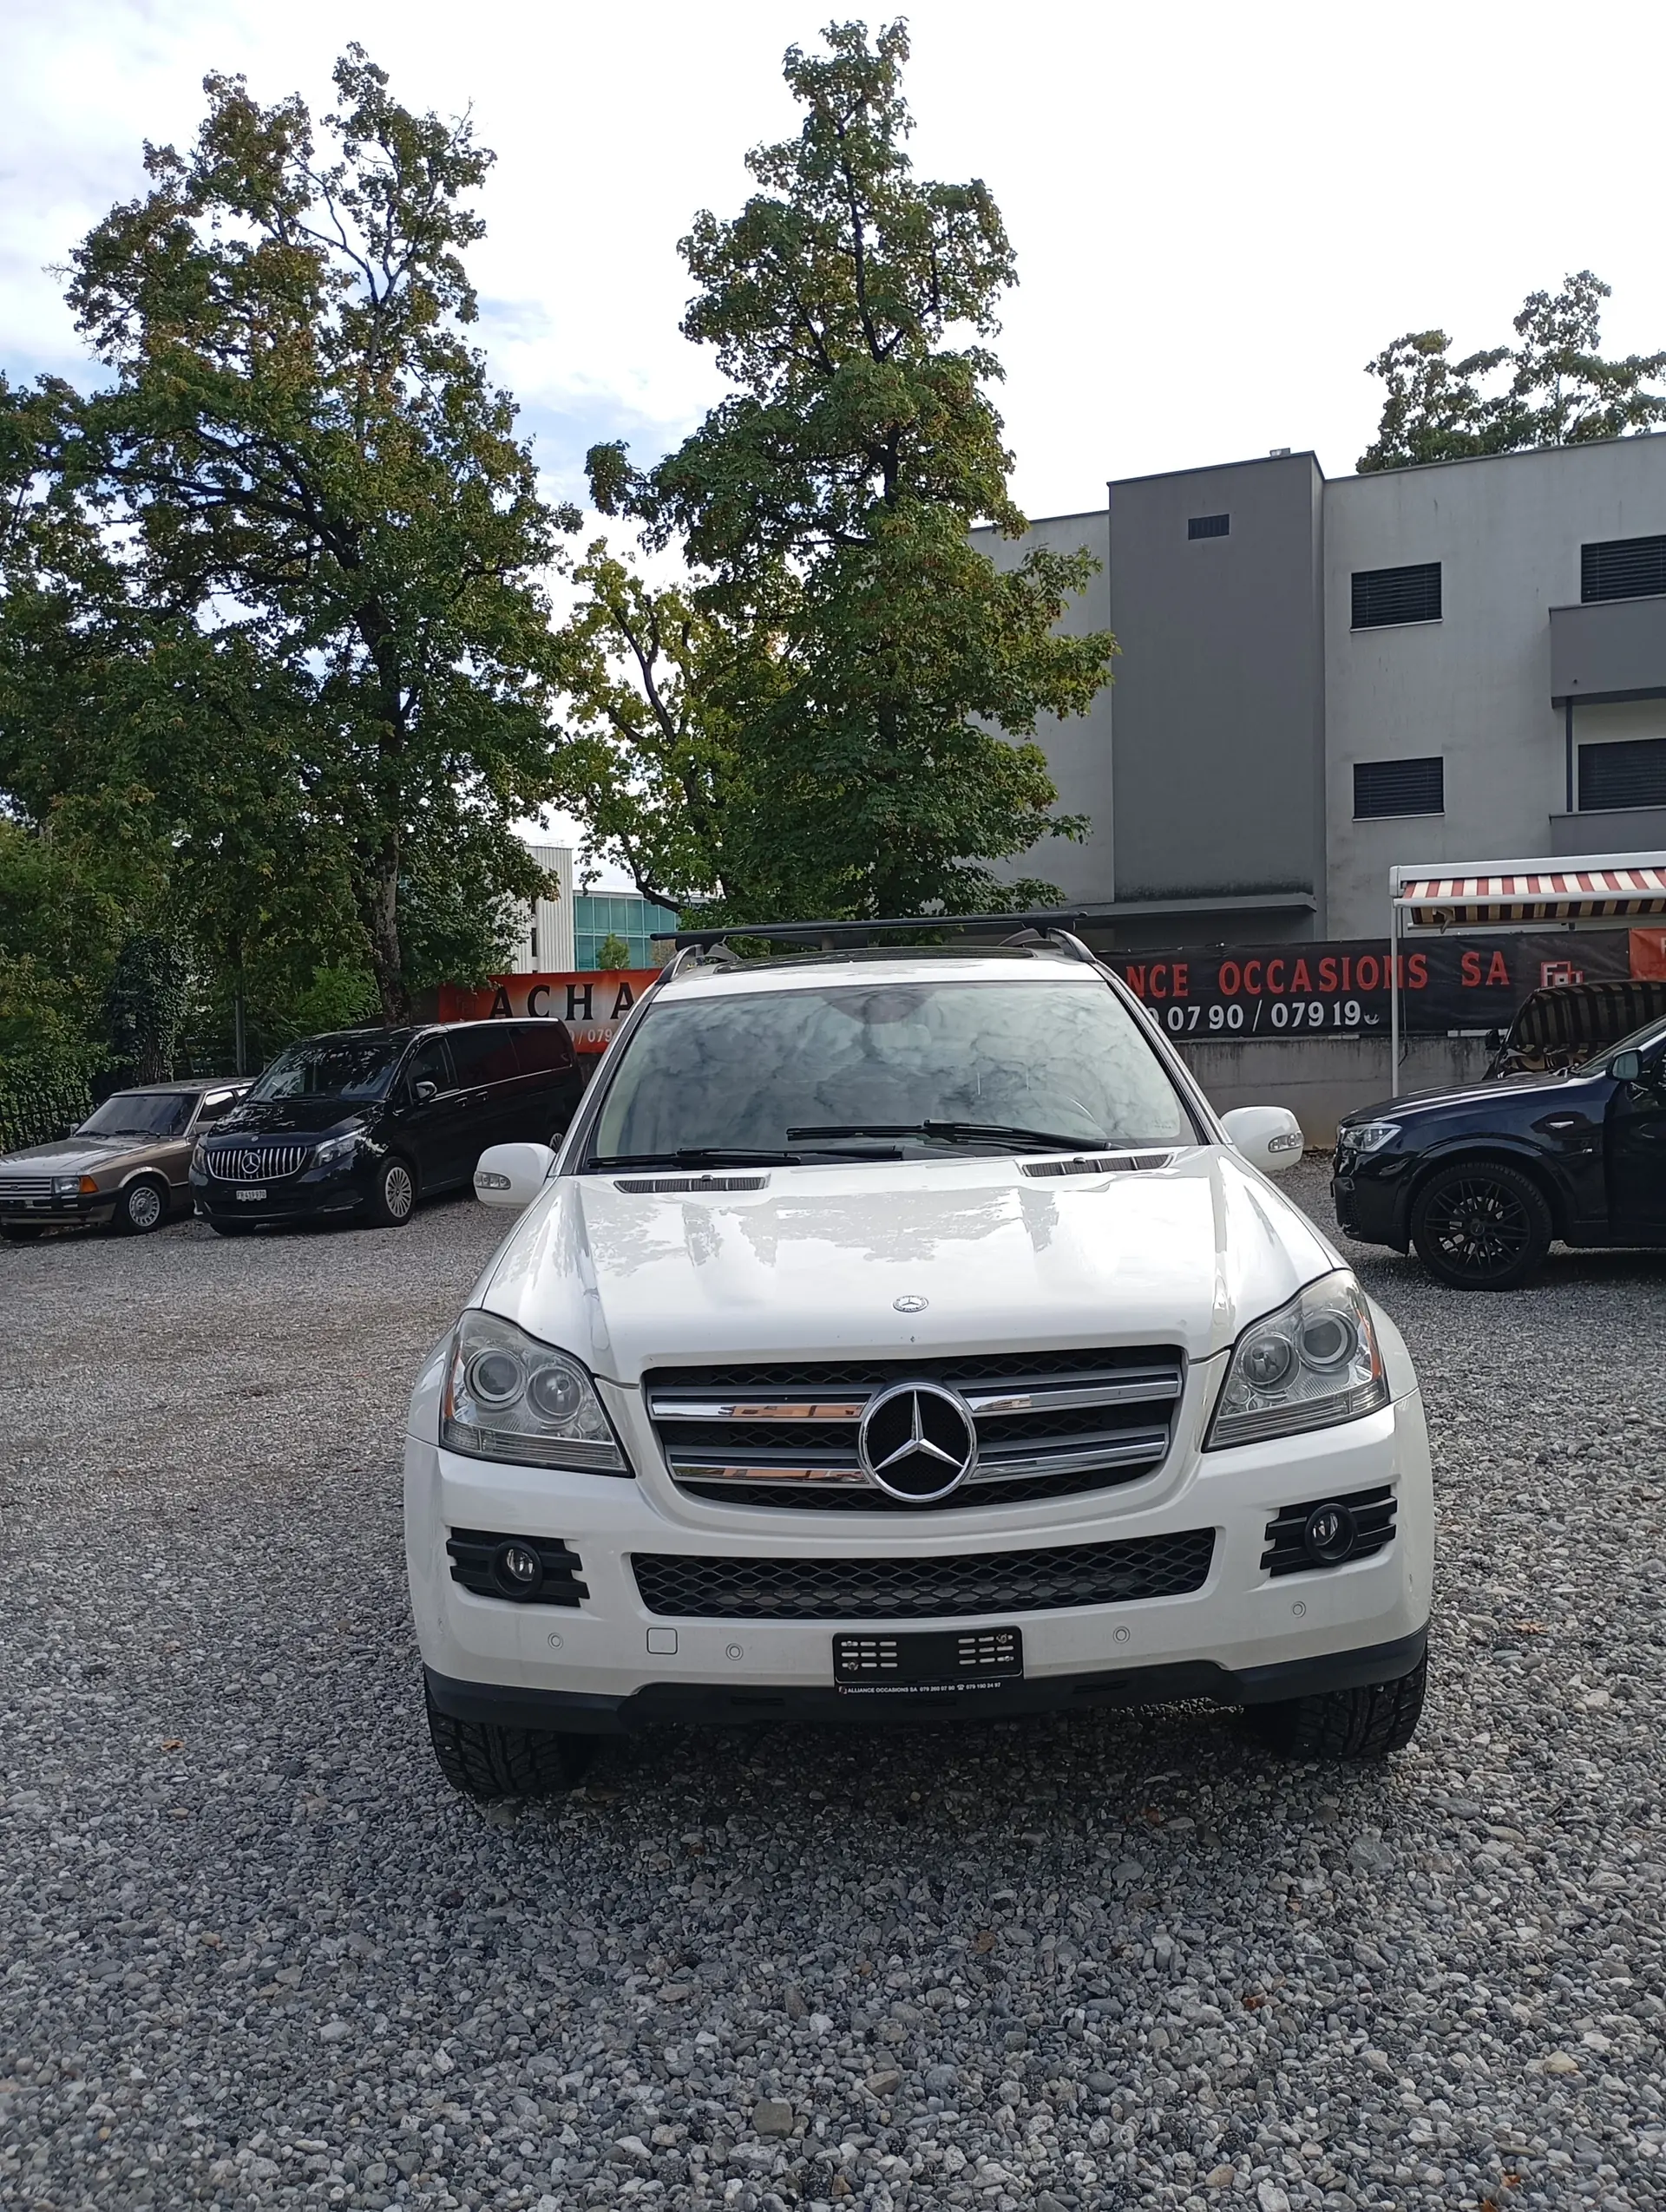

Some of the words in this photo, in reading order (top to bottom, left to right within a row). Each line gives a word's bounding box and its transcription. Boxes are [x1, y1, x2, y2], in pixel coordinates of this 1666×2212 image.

[1219, 954, 1428, 996] OCCASIONS
[1461, 951, 1510, 987] SA
[1167, 1006, 1201, 1031] 07
[1209, 1005, 1244, 1030] 90
[1271, 1001, 1324, 1028] 079
[587, 1028, 613, 1043] 079
